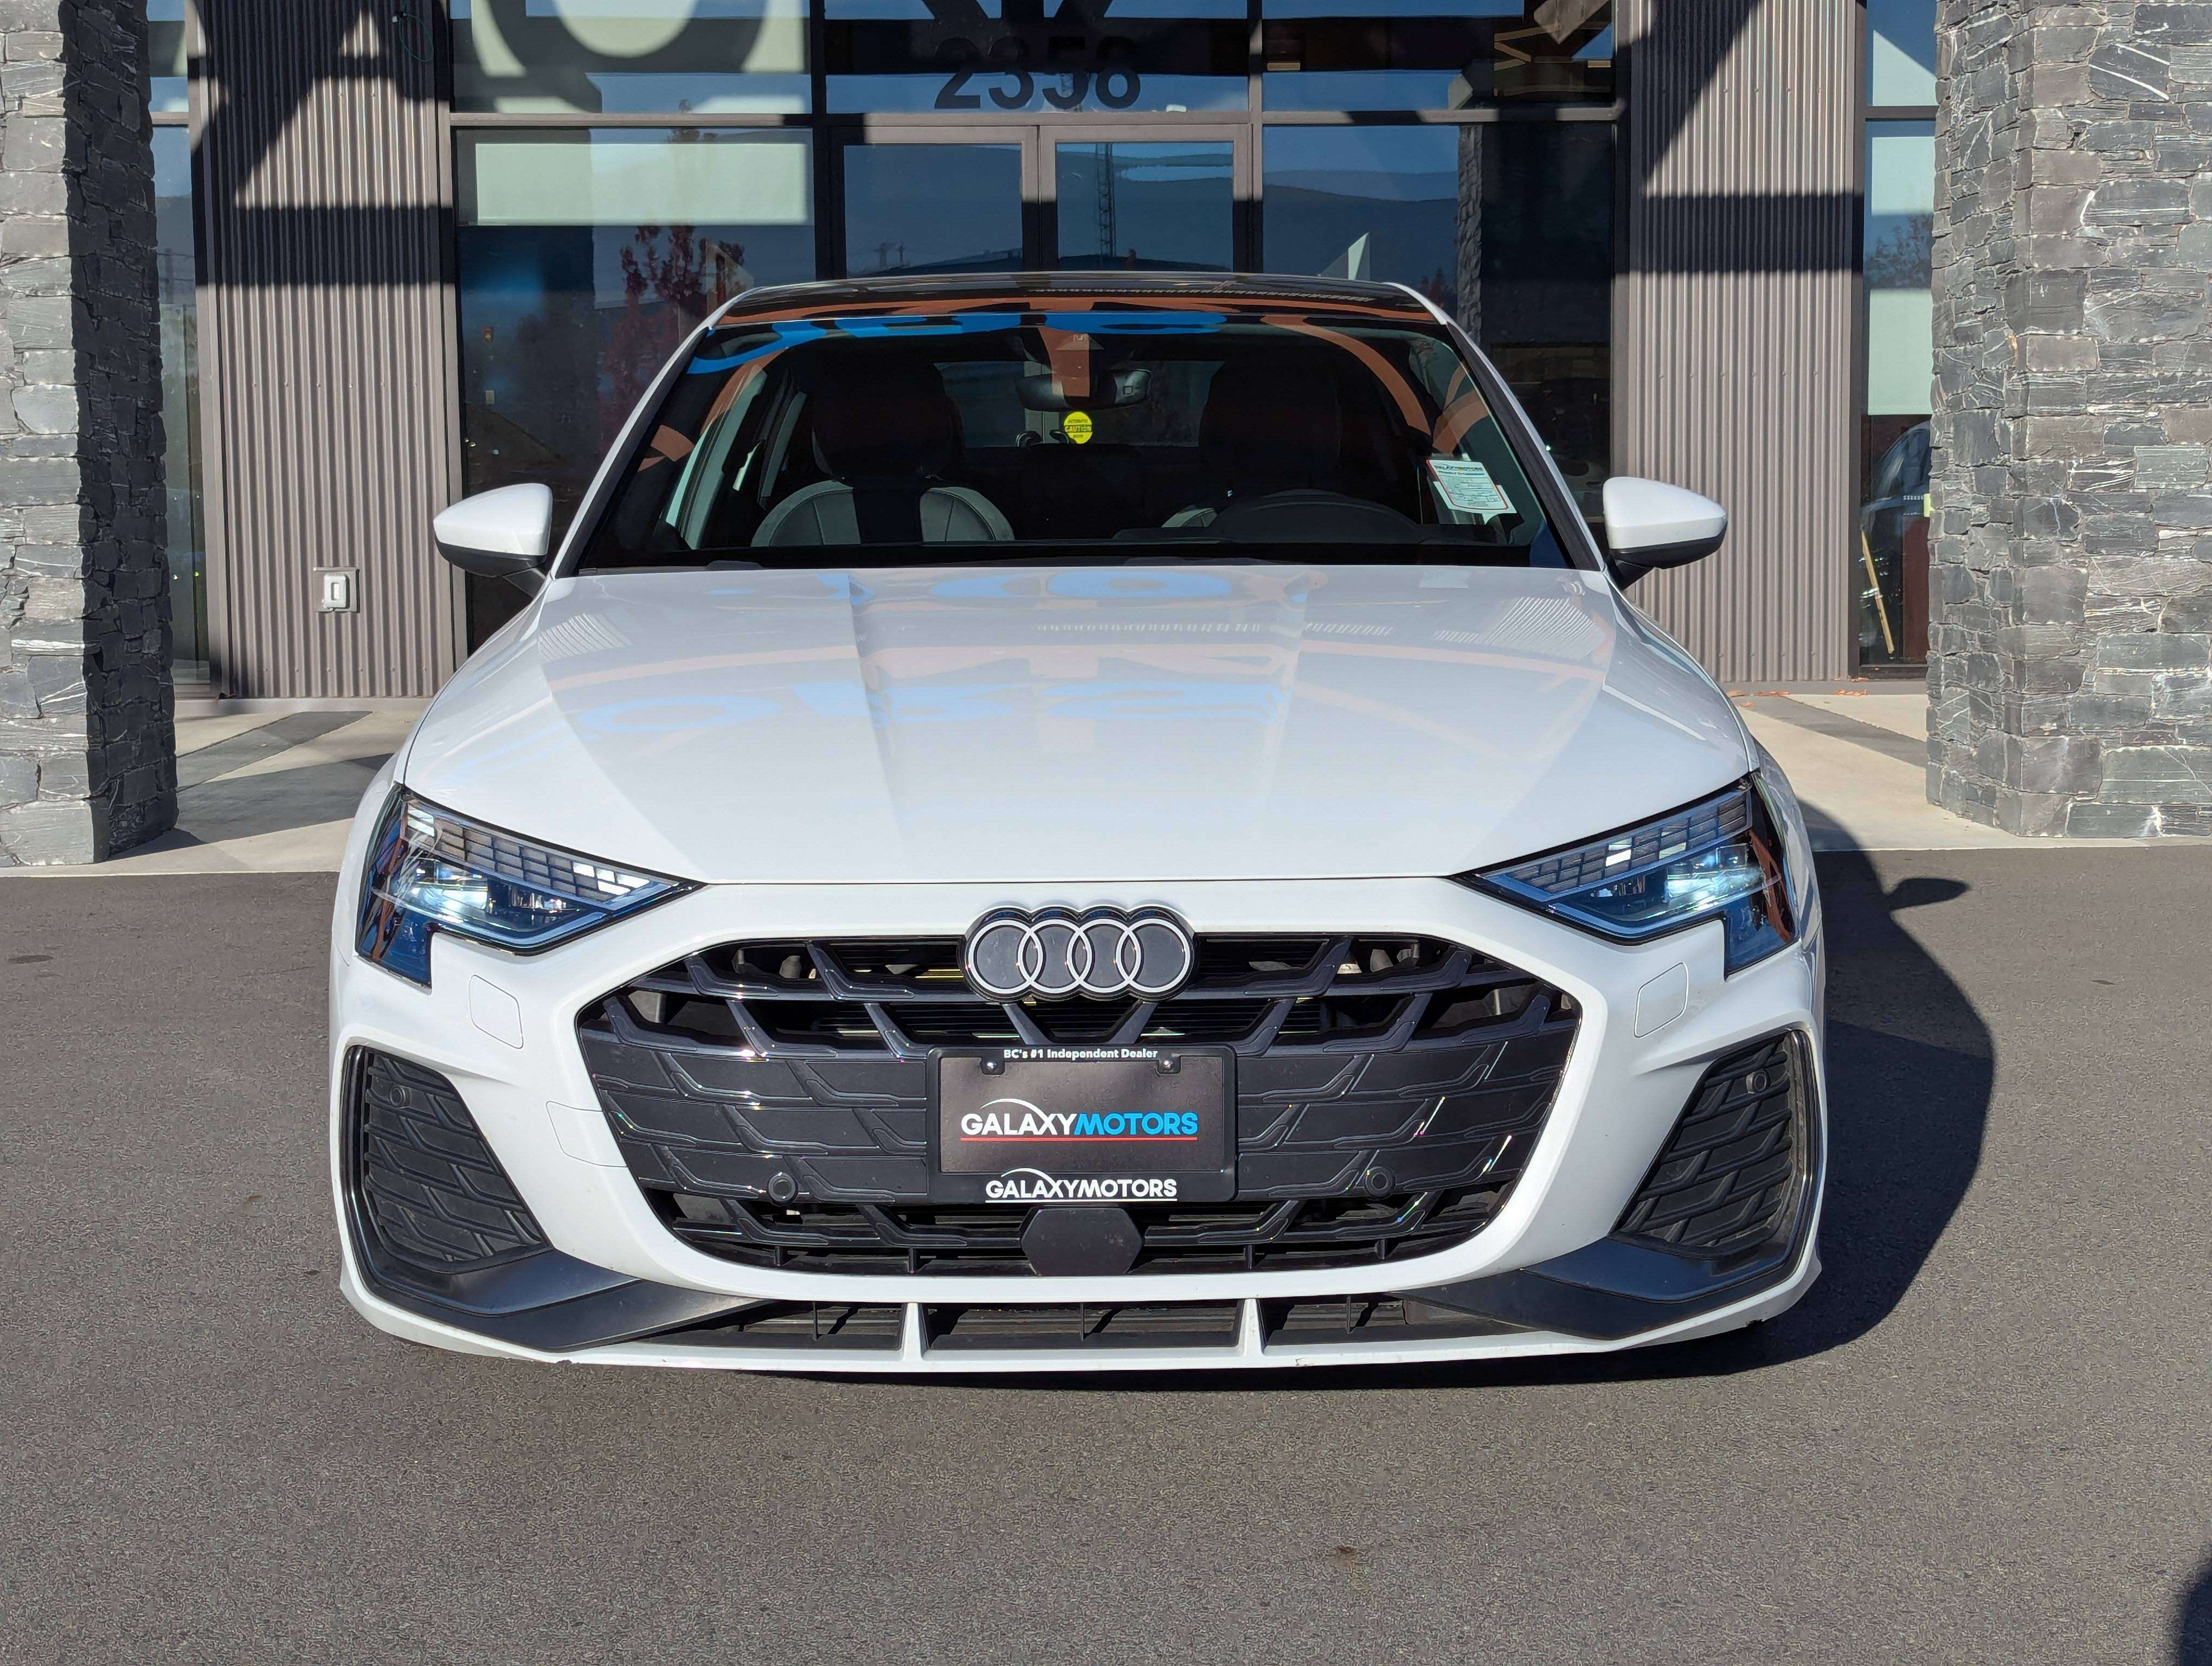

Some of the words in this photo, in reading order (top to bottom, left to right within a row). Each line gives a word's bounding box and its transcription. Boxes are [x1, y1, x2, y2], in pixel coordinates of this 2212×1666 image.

[935, 36, 1141, 109] 2358
[1004, 1049, 1028, 1058] BC's
[1031, 1049, 1043, 1058] #1
[1047, 1049, 1118, 1061] Independent
[1121, 1049, 1158, 1058] Dealer
